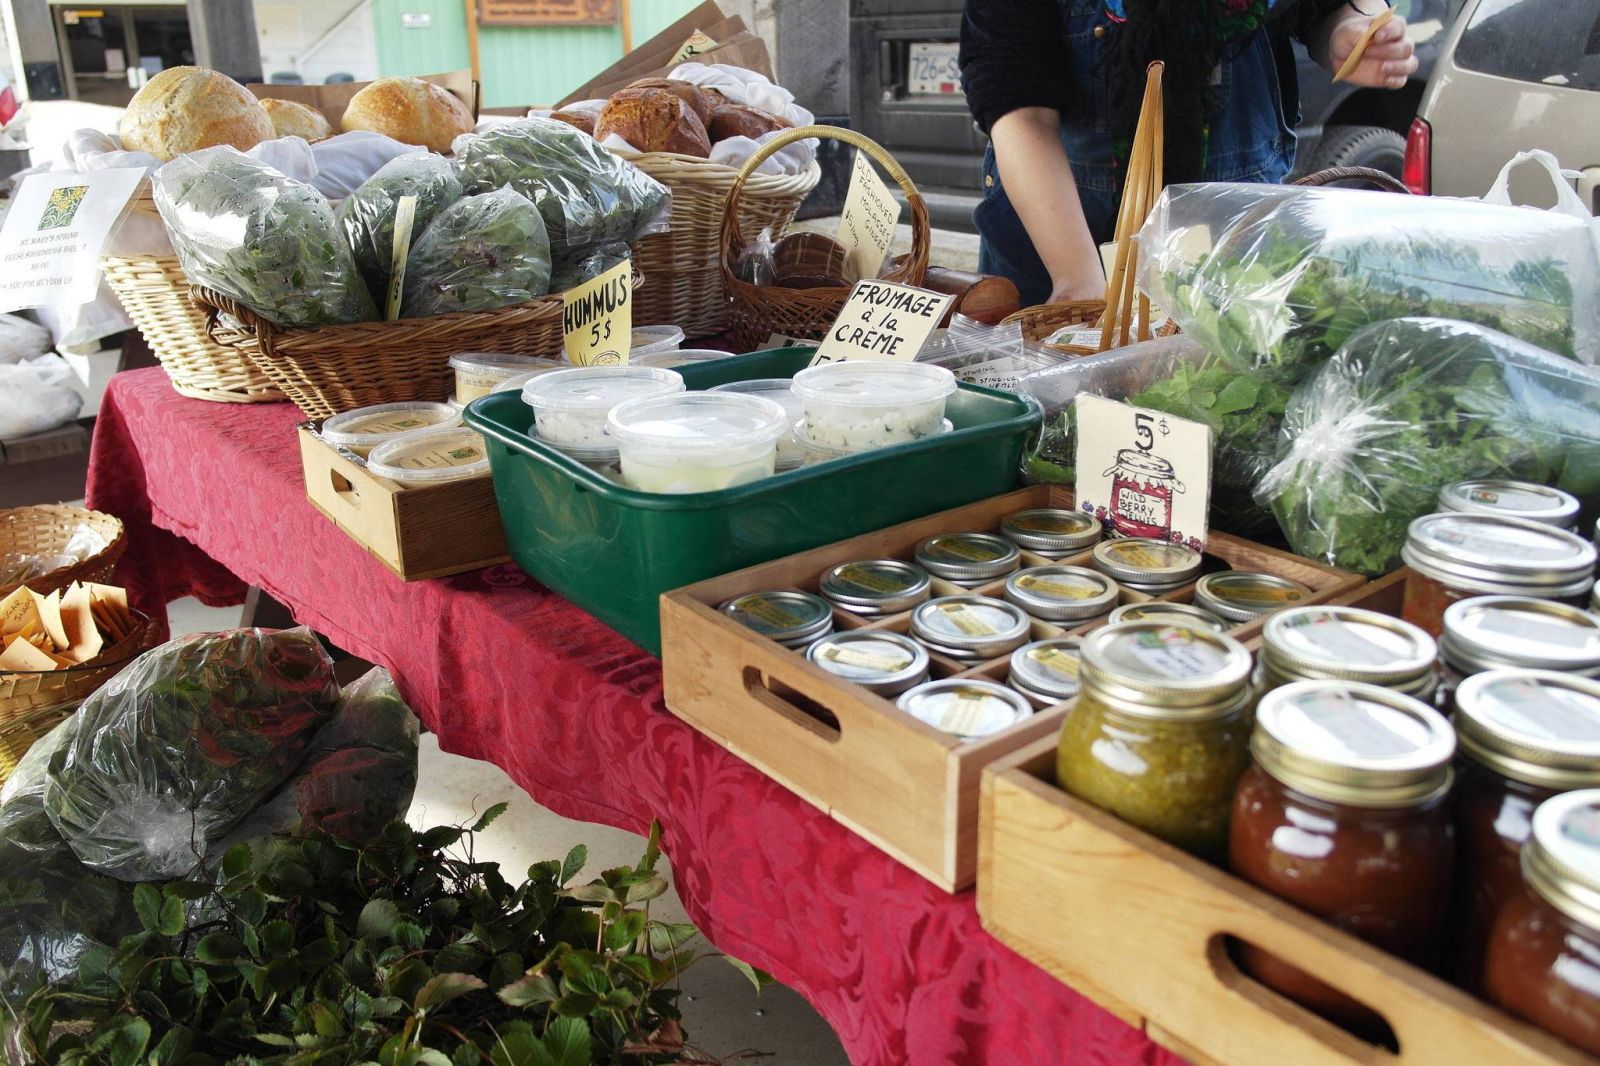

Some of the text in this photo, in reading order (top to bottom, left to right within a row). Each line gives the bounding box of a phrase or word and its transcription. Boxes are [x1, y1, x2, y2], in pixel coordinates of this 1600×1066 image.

[859, 176, 893, 225] FASHIONED
[860, 196, 890, 243] MOLASSES
[63, 243, 87, 254] BRED
[864, 219, 886, 254] GINGER
[564, 274, 627, 335] HUMMUS
[851, 284, 941, 317] FROMAGE
[861, 307, 898, 331] à la
[835, 324, 904, 356] CRÈME
[1120, 499, 1155, 517] BERRY
[1121, 490, 1147, 504] WILD
